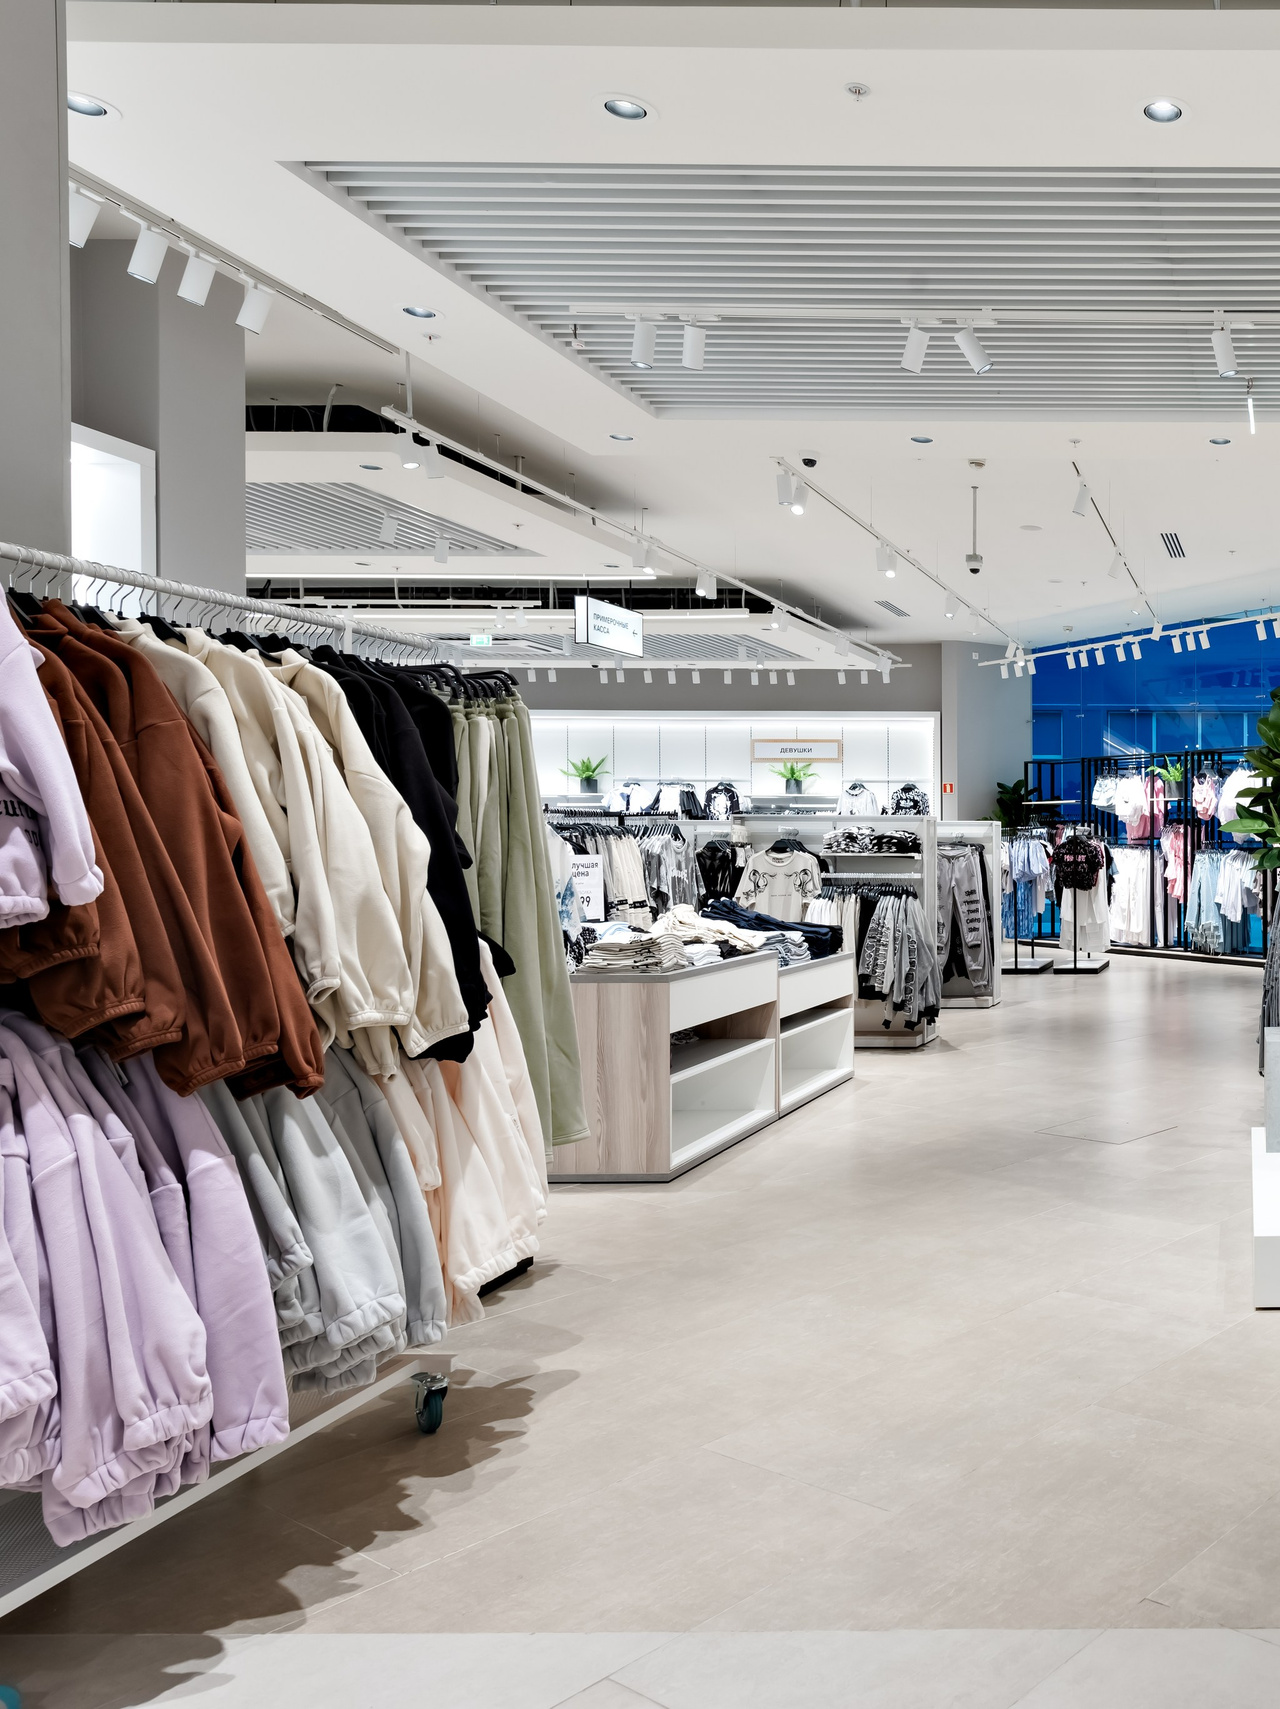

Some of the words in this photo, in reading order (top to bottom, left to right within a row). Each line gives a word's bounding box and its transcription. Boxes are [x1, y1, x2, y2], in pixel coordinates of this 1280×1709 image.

[593, 612, 629, 630] ПРИМЕРОЧНЫЕ
[593, 624, 610, 634] КАССА
[571, 862, 599, 871] лучшая
[580, 895, 591, 907] 99
